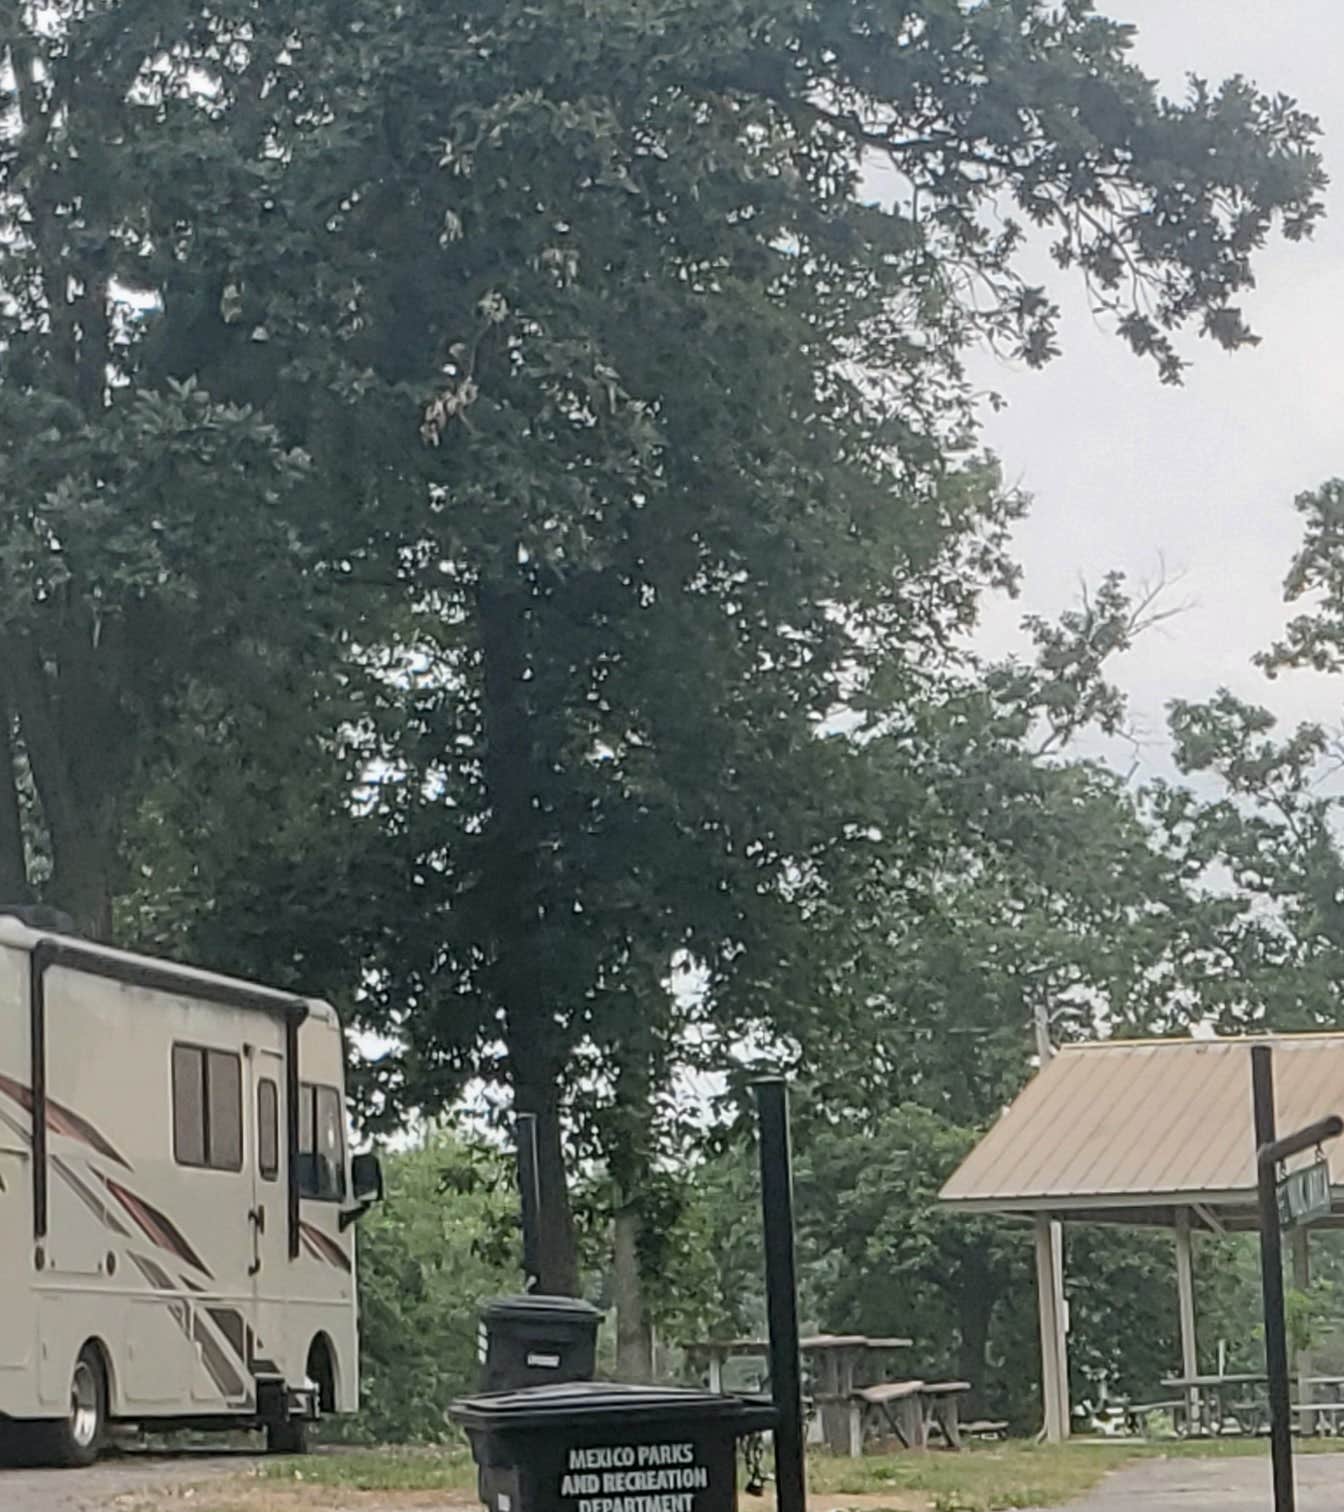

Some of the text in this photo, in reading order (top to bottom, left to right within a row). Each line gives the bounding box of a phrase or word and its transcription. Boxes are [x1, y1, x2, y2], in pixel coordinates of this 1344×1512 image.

[569, 1443, 694, 1469] MEXICO PARKS
[561, 1467, 708, 1496] AND RECREATION
